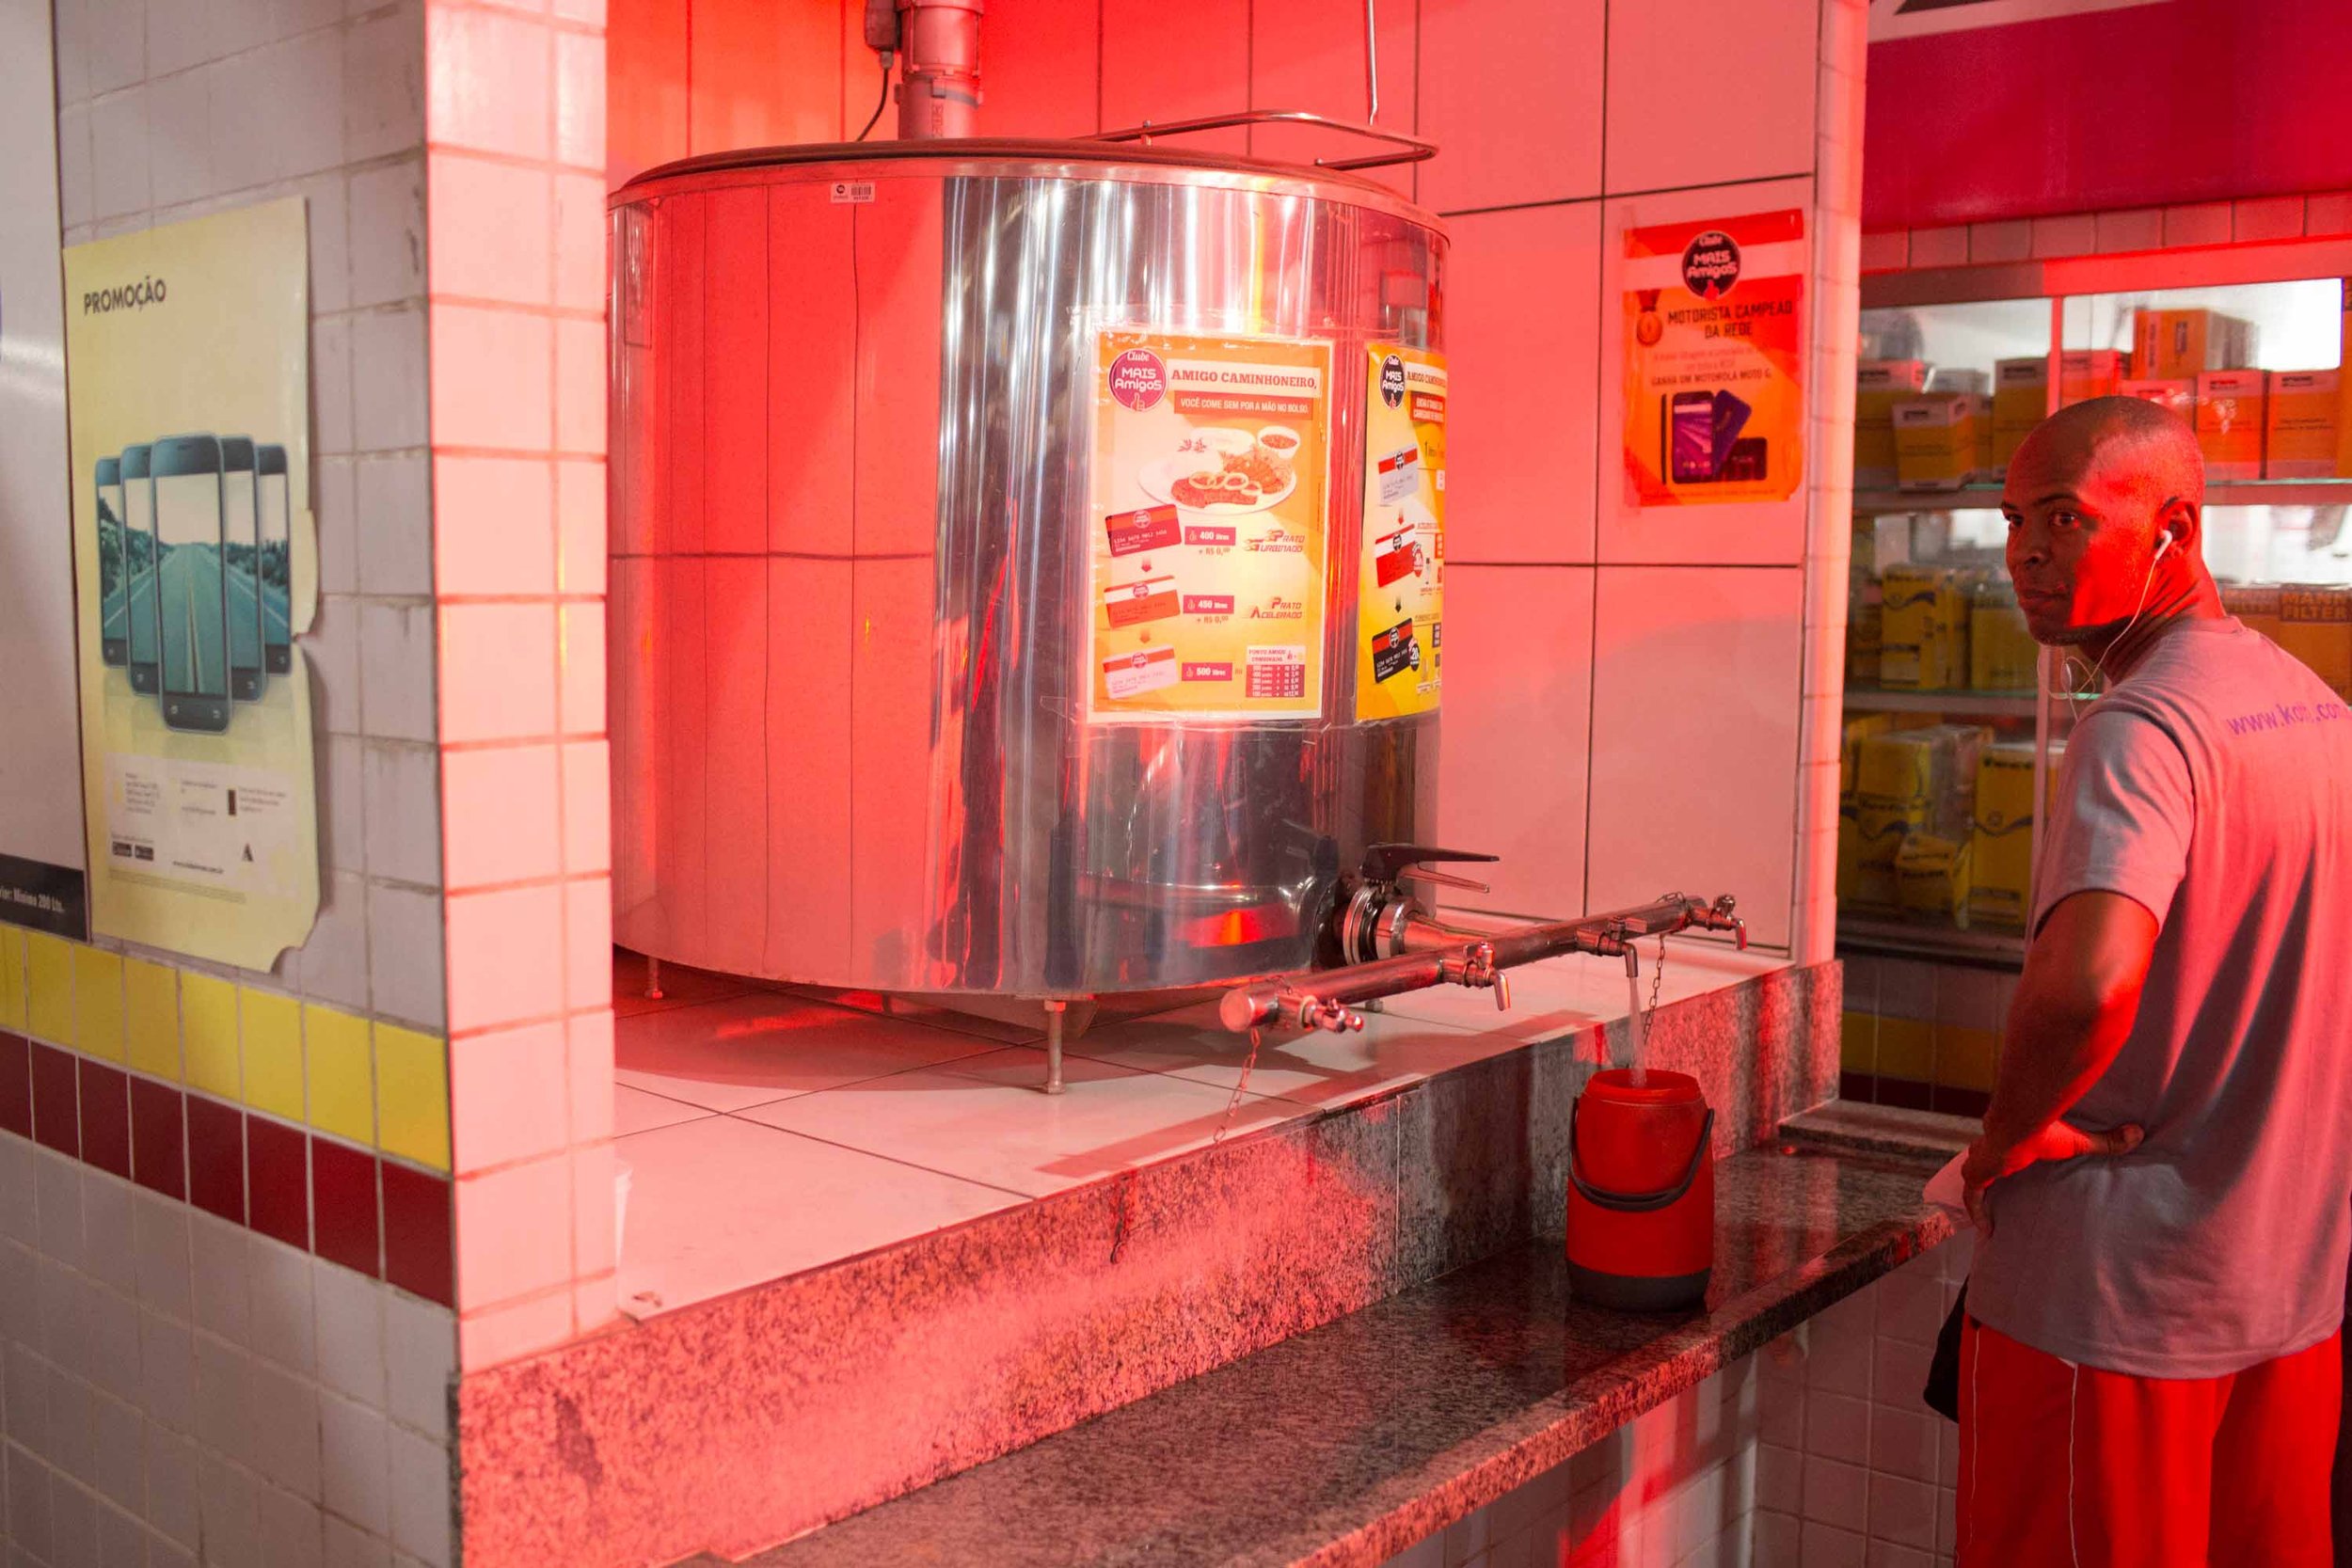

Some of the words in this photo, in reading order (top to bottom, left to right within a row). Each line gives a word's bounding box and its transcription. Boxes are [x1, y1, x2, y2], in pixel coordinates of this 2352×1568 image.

[1693, 249, 1730, 265] MAIS
[83, 275, 167, 316] PROMOÇÃO
[1667, 306, 1731, 325] MOTORISTA
[1705, 325, 1720, 339] DA
[1724, 322, 1753, 337] REDE
[1121, 368, 1156, 380] MAIS
[1171, 370, 1218, 383] AMIGO
[1386, 371, 1402, 381] MAIS
[1181, 396, 1200, 407] VOCÊ
[1201, 399, 1222, 409] COME
[1223, 400, 1239, 410] SEM
[1240, 401, 1254, 411] POR
[1200, 531, 1215, 540] 400
[1198, 600, 1213, 610] 450
[1271, 596, 1302, 610] PRATO
